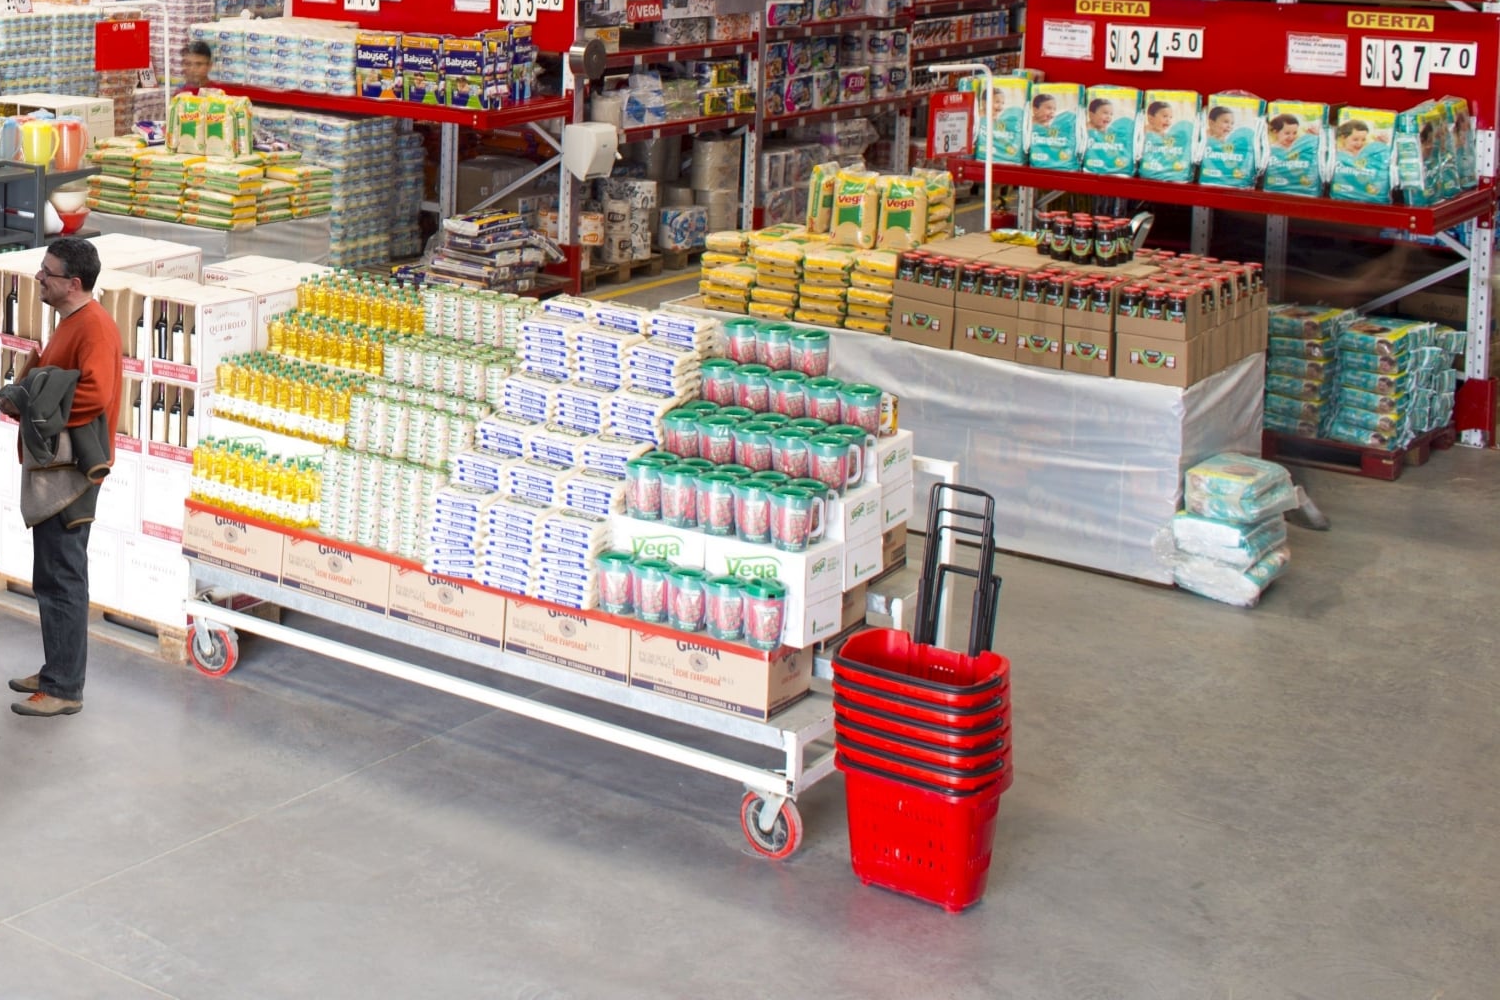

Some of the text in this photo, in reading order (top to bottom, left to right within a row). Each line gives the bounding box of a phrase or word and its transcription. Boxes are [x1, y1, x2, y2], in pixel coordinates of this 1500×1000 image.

[637, 4, 660, 17] VEGA
[1078, 0, 1147, 14] OFERTA
[119, 23, 136, 31] VEGA
[1351, 13, 1431, 29] OFERTA
[357, 49, 389, 62] Babysec
[403, 53, 434, 65] Babysec
[445, 57, 478, 68] Babysec
[887, 199, 915, 209] Vega
[209, 320, 247, 335] QUEIROLO
[632, 536, 681, 558] Vega
[725, 558, 778, 579] Vega
[673, 667, 721, 687] LECHE EVAPORADA
[653, 684, 687, 700] ENRIQUECIDA
[687, 692, 699, 702] CON
